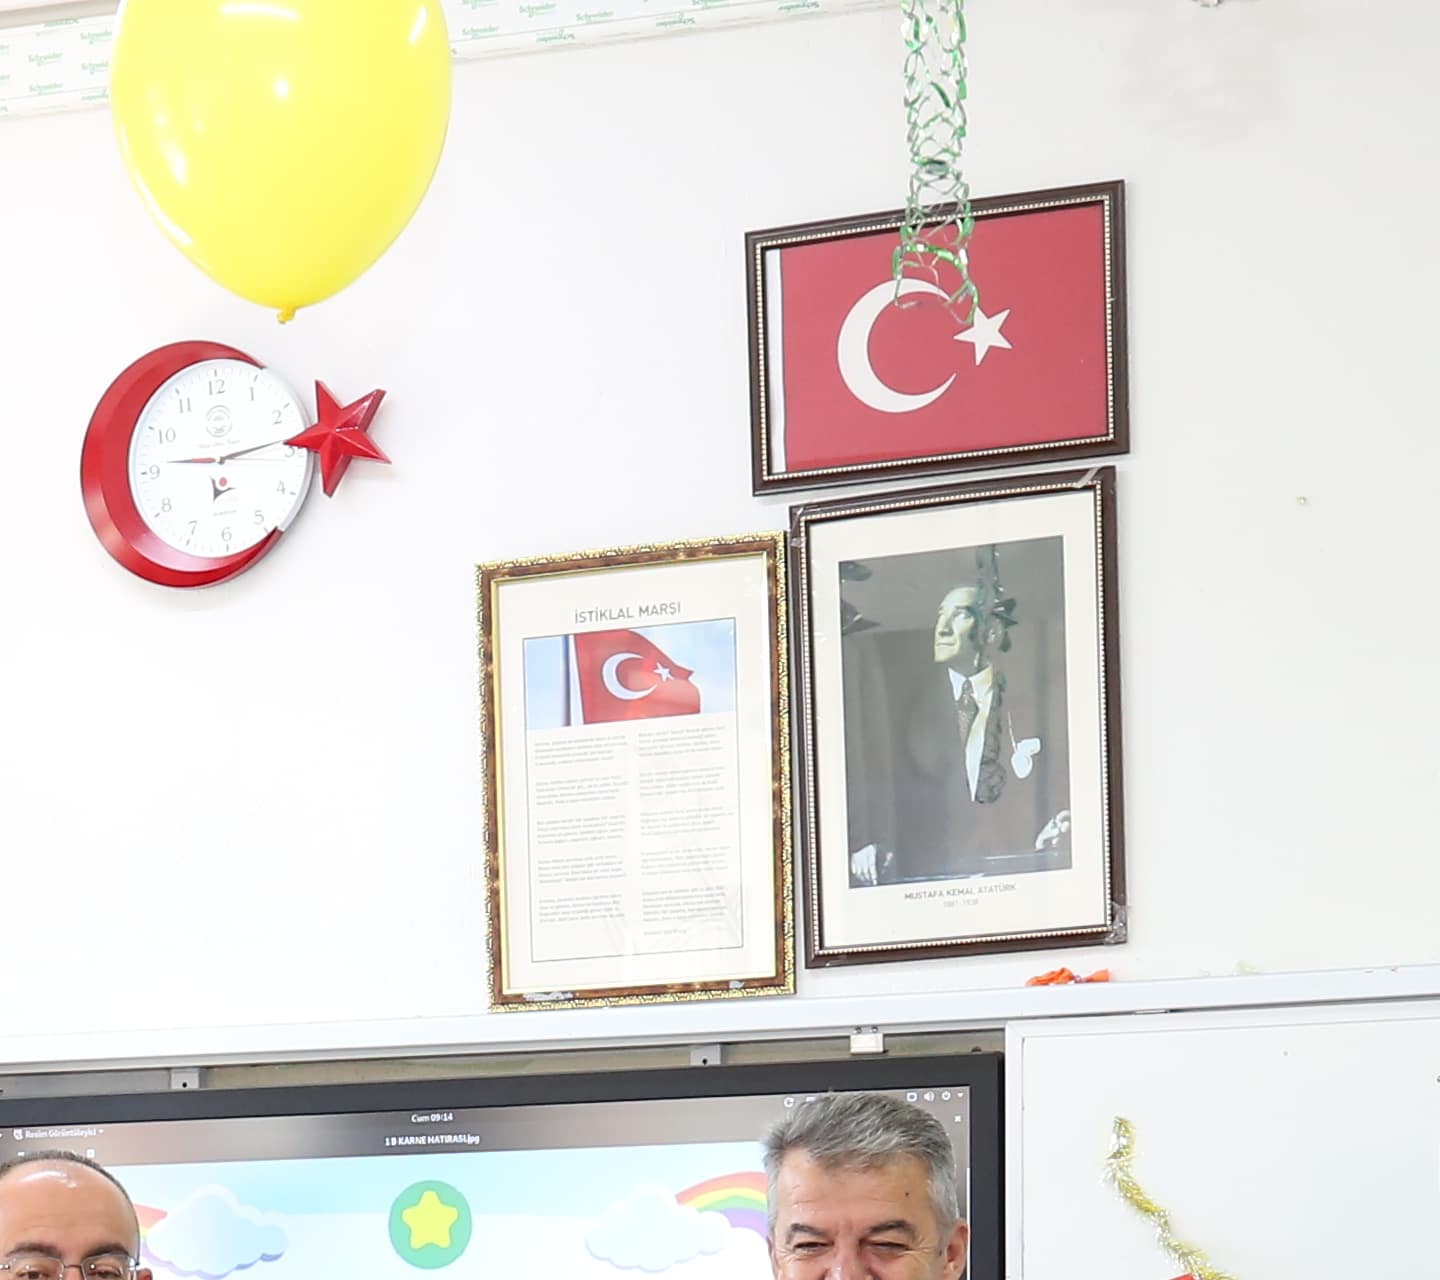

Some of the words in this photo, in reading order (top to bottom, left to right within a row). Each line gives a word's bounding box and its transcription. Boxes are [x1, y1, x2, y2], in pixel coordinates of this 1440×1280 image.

[208, 379, 225, 395] 12
[249, 386, 255, 401] 1
[178, 397, 192, 413] 11
[272, 410, 282, 425] 2
[158, 428, 176, 444] 10
[148, 464, 160, 480] 9
[276, 480, 286, 495] 4
[161, 498, 172, 512] 8
[254, 510, 264, 525] 5
[188, 520, 198, 536] 7
[221, 526, 232, 541] 6
[575, 606, 634, 624] İSTİKLAL
[639, 601, 681, 617] MARŞI
[904, 890, 945, 900] MUSTAFA
[946, 887, 975, 897] KEMAL
[978, 882, 1017, 894] ATATÜRK
[430, 1112, 454, 1122] 09:14
